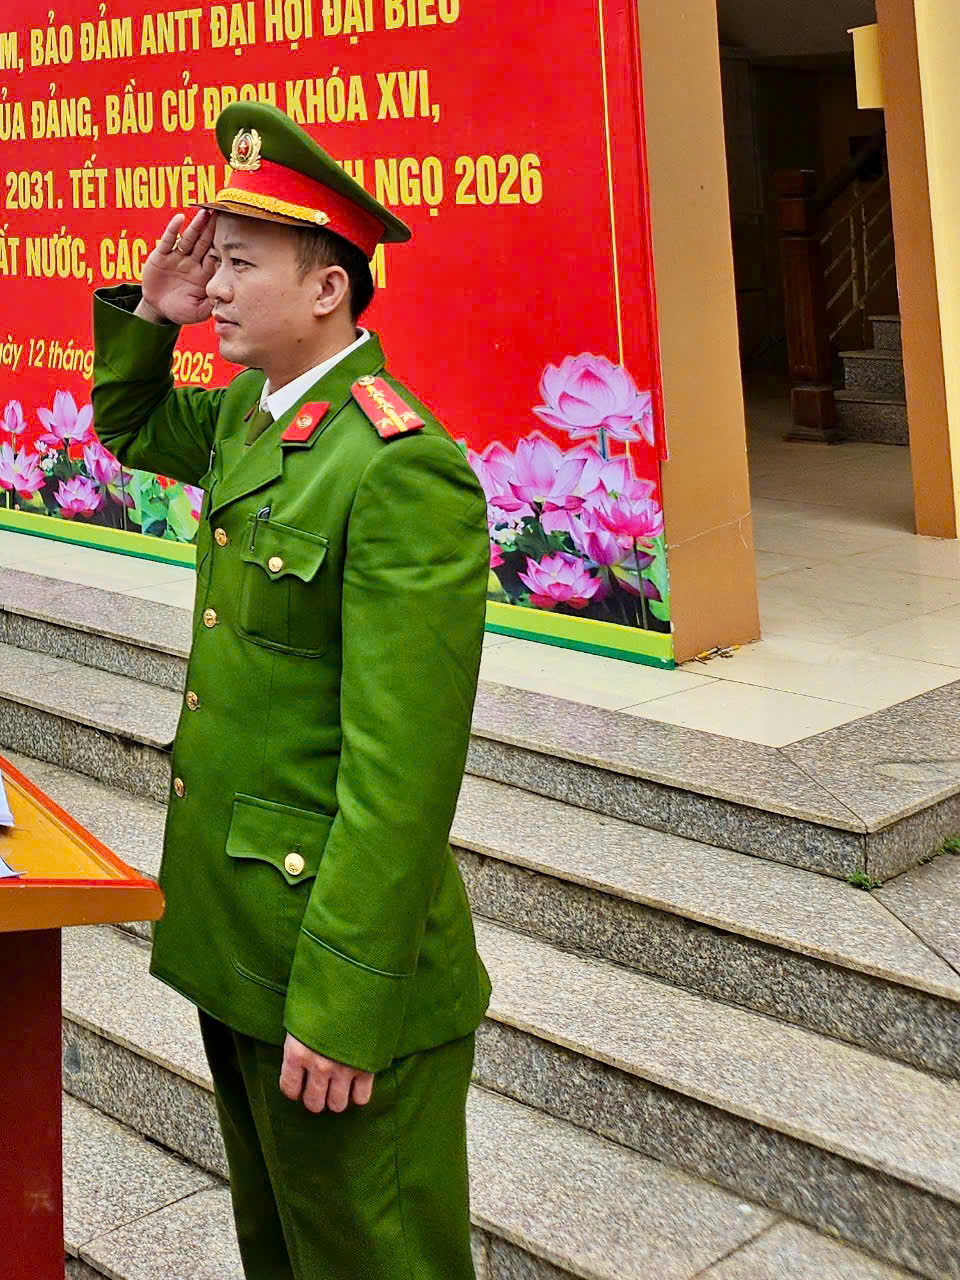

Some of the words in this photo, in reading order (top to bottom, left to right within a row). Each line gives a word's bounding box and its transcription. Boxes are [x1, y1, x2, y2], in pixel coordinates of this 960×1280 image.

[30, 10, 73, 67] BẢO
[80, 3, 132, 61] ĐẢM
[140, 8, 202, 56] ANTT
[211, 1, 255, 57] ĐẠI
[31, 83, 98, 141] ĐẢNG,
[106, 79, 154, 135] BẦU
[161, 70, 198, 133] CỬ
[286, 67, 368, 125] KHÓA
[377, 69, 440, 123] XVI,
[70, 154, 108, 209] TẾT
[115, 158, 216, 209] NGUYÊN
[376, 156, 444, 216] NGỌ
[455, 154, 543, 205] 2026
[26, 226, 93, 283] NƯỚC,
[100, 229, 147, 280] CÁC
[28, 339, 44, 367] 12
[48, 339, 95, 380] tháng
[172, 350, 214, 384] 2025
